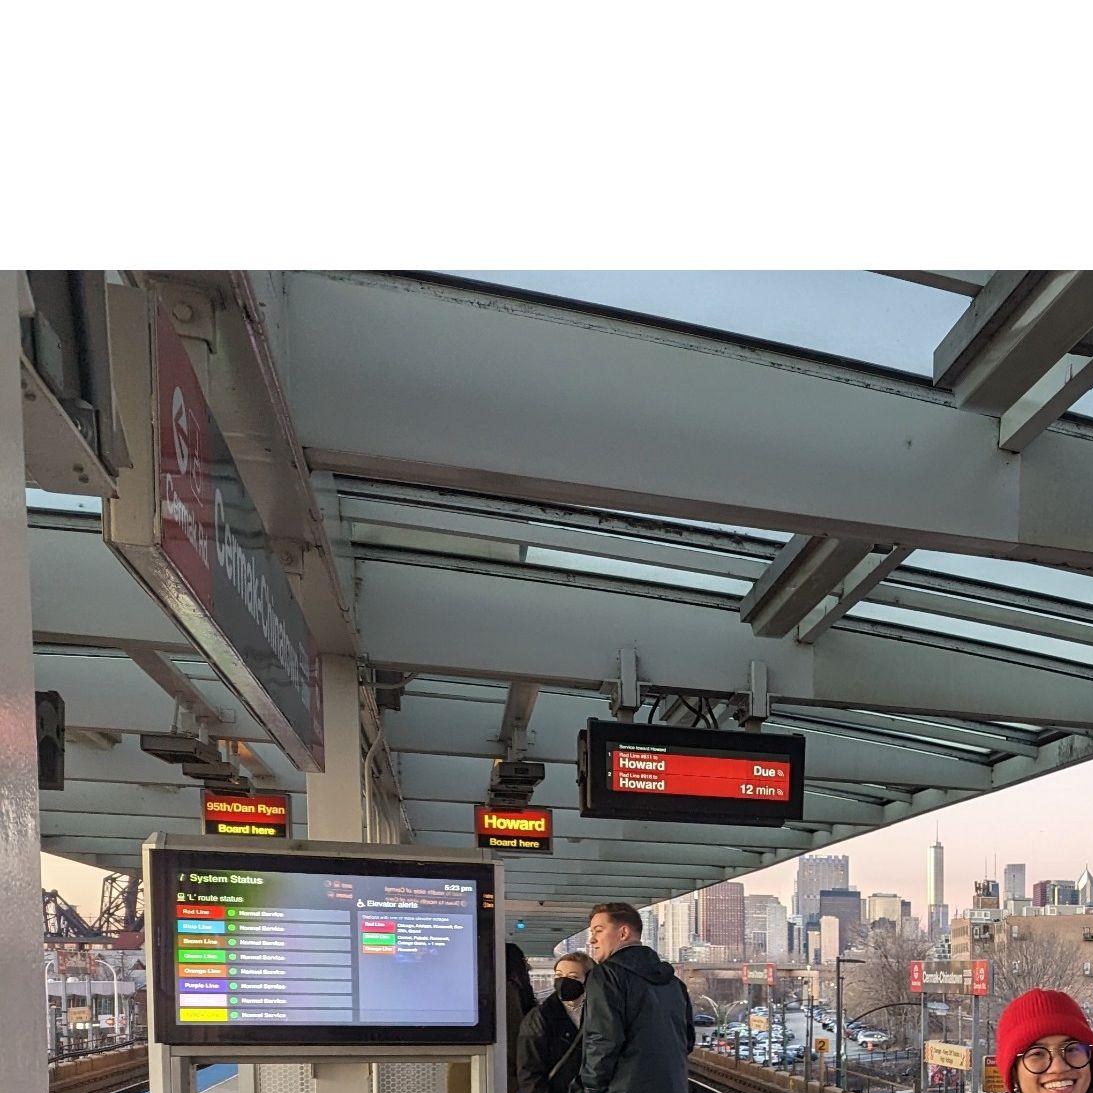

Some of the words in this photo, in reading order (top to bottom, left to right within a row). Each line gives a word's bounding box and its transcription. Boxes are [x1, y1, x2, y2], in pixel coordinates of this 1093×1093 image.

[620, 758, 665, 770] Howard
[753, 765, 776, 777] Due
[620, 778, 665, 790] Howard
[740, 784, 753, 795] 12
[756, 786, 775, 795] min
[206, 802, 255, 813] 95th/Dan
[257, 804, 285, 816] Ryan
[484, 814, 546, 832] Howard
[218, 824, 250, 834] Board
[251, 826, 276, 835] here
[489, 837, 517, 847] Board
[519, 839, 539, 848] here
[189, 873, 228, 884] System
[230, 875, 264, 885] Status
[367, 900, 396, 908] Elevator
[398, 901, 418, 909] alerts
[184, 982, 205, 990] Purple
[818, 1040, 825, 1051] 2
